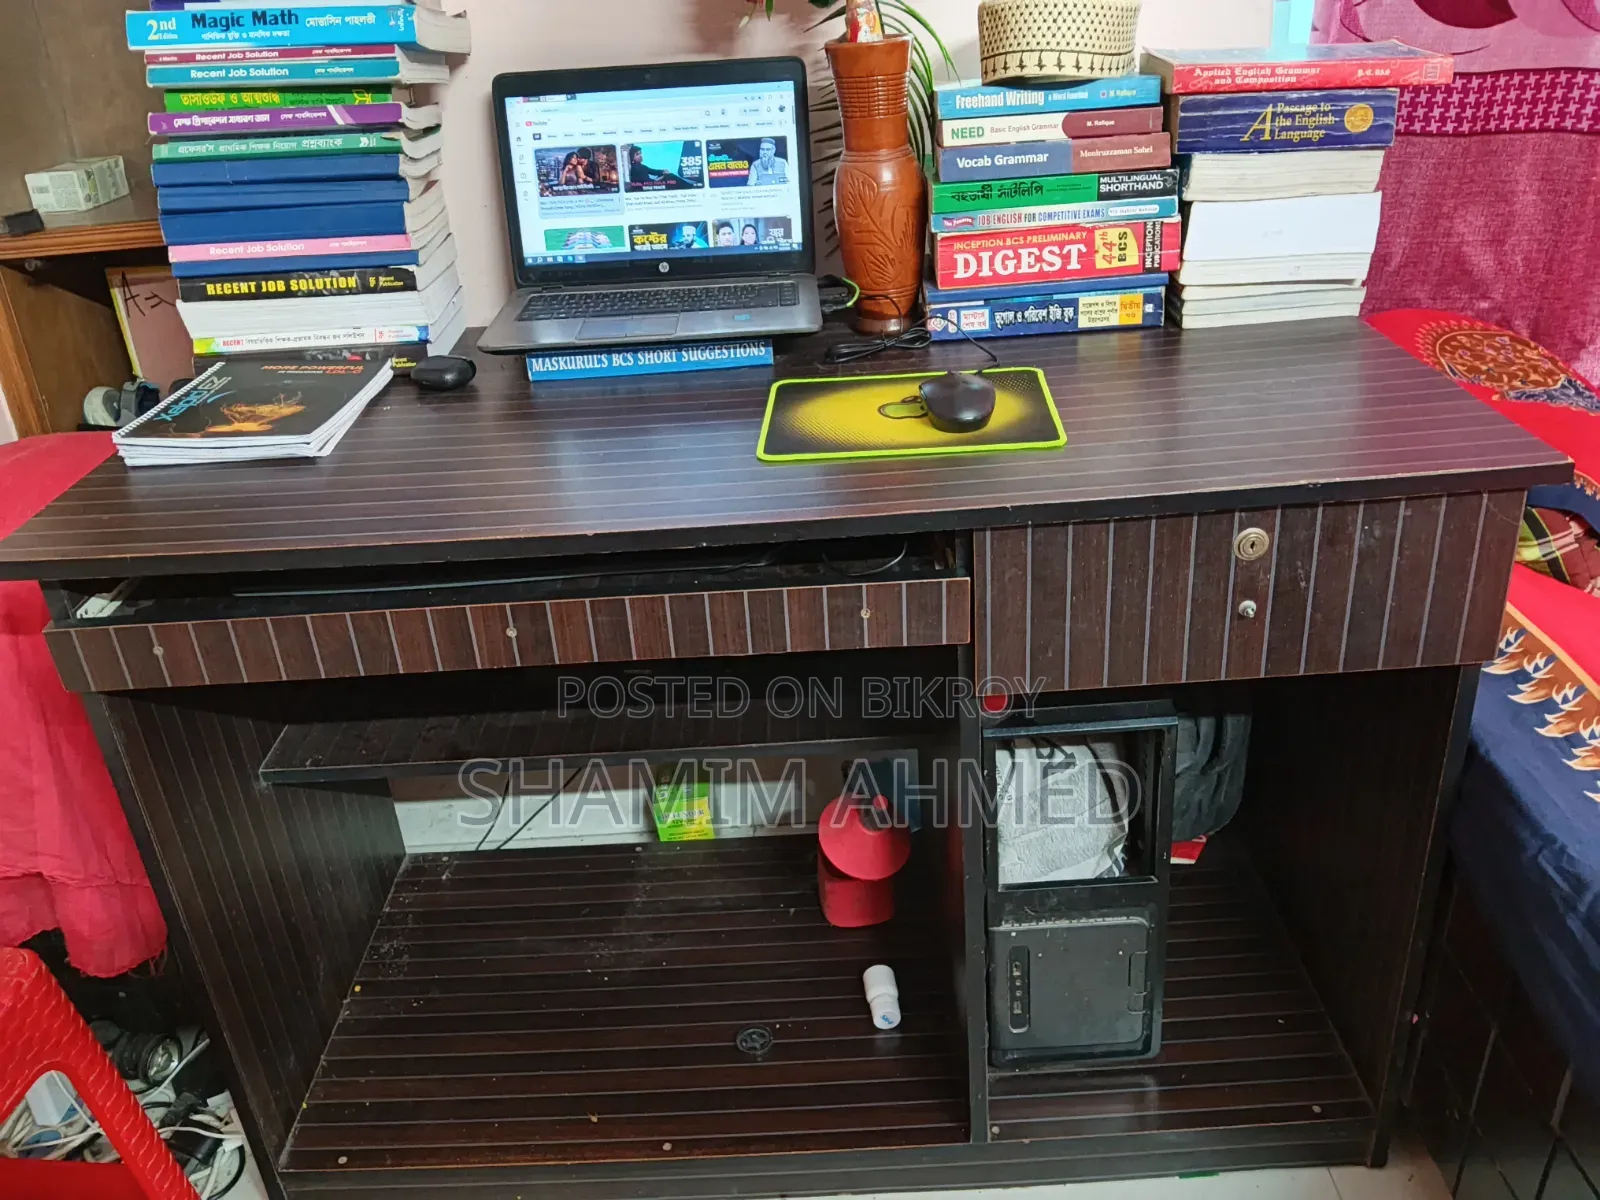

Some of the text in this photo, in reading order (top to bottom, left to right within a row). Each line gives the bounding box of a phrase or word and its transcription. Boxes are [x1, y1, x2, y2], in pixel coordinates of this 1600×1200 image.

[191, 9, 299, 32] Magic Math
[147, 17, 176, 40] 2nd
[195, 50, 279, 61] Recent Job Solution
[190, 67, 289, 79] Recent Job Solution
[1193, 66, 1321, 77] Applied English Grammar
[1214, 75, 1297, 84] and Composition
[230, 92, 238, 104] ও
[955, 91, 1004, 109] Freehand
[1006, 90, 1045, 106] Writing
[1240, 102, 1331, 142] A Passage to
[1275, 112, 1335, 127] the English
[951, 126, 985, 140] NEED
[990, 123, 1059, 134] Basic English Grammar
[1274, 128, 1326, 142] Language
[1080, 145, 1153, 158] Moniruzzaman Sohel
[680, 155, 702, 167] 385
[956, 153, 1049, 168] Vocab Grammar
[1100, 173, 1164, 183] MULTILINGUAL
[1100, 181, 1164, 193] SHORTHAND
[978, 214, 991, 226] JOB
[993, 212, 1023, 225] ENGLISH
[1024, 212, 1037, 222] FOR
[1038, 209, 1081, 222] COMPETITIVE
[1083, 207, 1105, 218] EXAMS
[953, 231, 1087, 250] INCEPTION BCS PRELIMINARY
[1118, 231, 1128, 263] BCS
[1145, 221, 1153, 268] INCEPTION
[209, 242, 305, 255] Recent Job Solution
[1099, 231, 1117, 265] 44th
[953, 244, 1087, 279] DIGEST
[206, 281, 257, 295] RECENT
[261, 279, 286, 293] JOB
[289, 276, 356, 291] SOLUTION
[1016, 312, 1022, 322] ও
[222, 339, 244, 347] RECENT
[532, 341, 766, 372] MASKURUL'S BCS SHORT SUGGESTIONS
